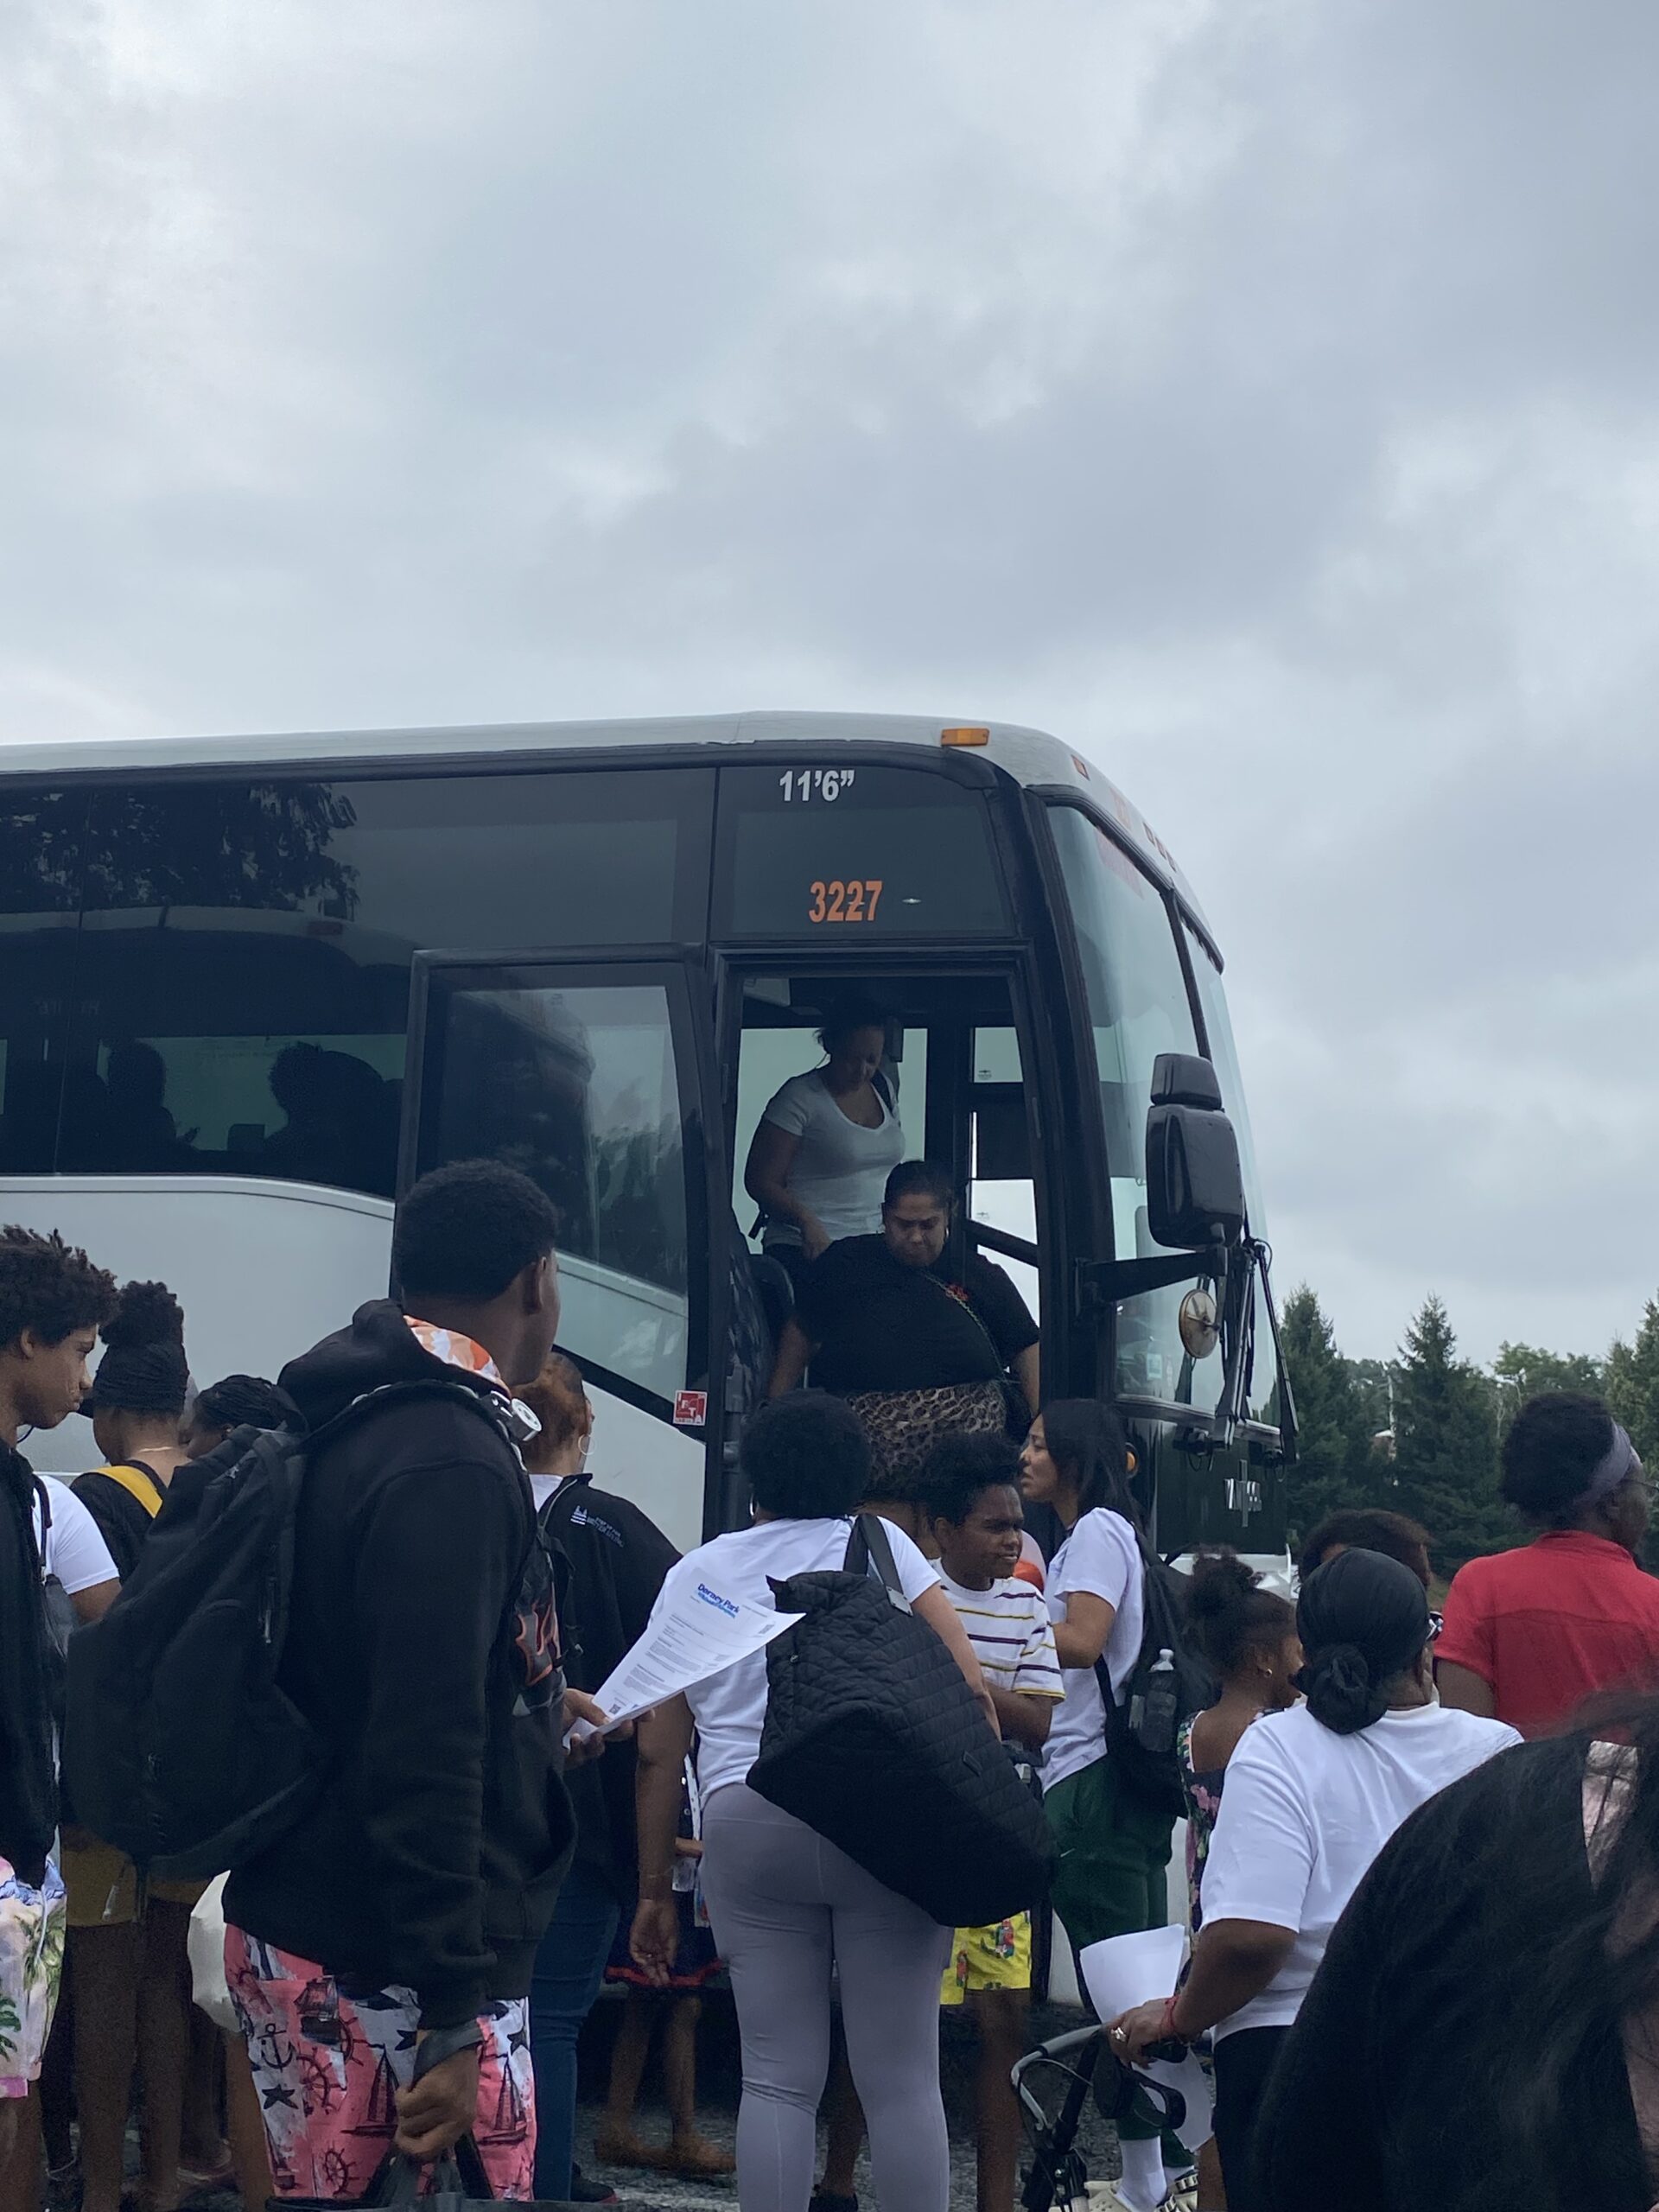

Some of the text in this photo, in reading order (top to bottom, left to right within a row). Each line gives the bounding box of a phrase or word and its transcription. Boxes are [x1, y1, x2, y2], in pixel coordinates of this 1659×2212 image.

[809, 880, 882, 922] 3227
[697, 1583, 724, 1605] Dorney
[723, 1599, 739, 1613] Park
